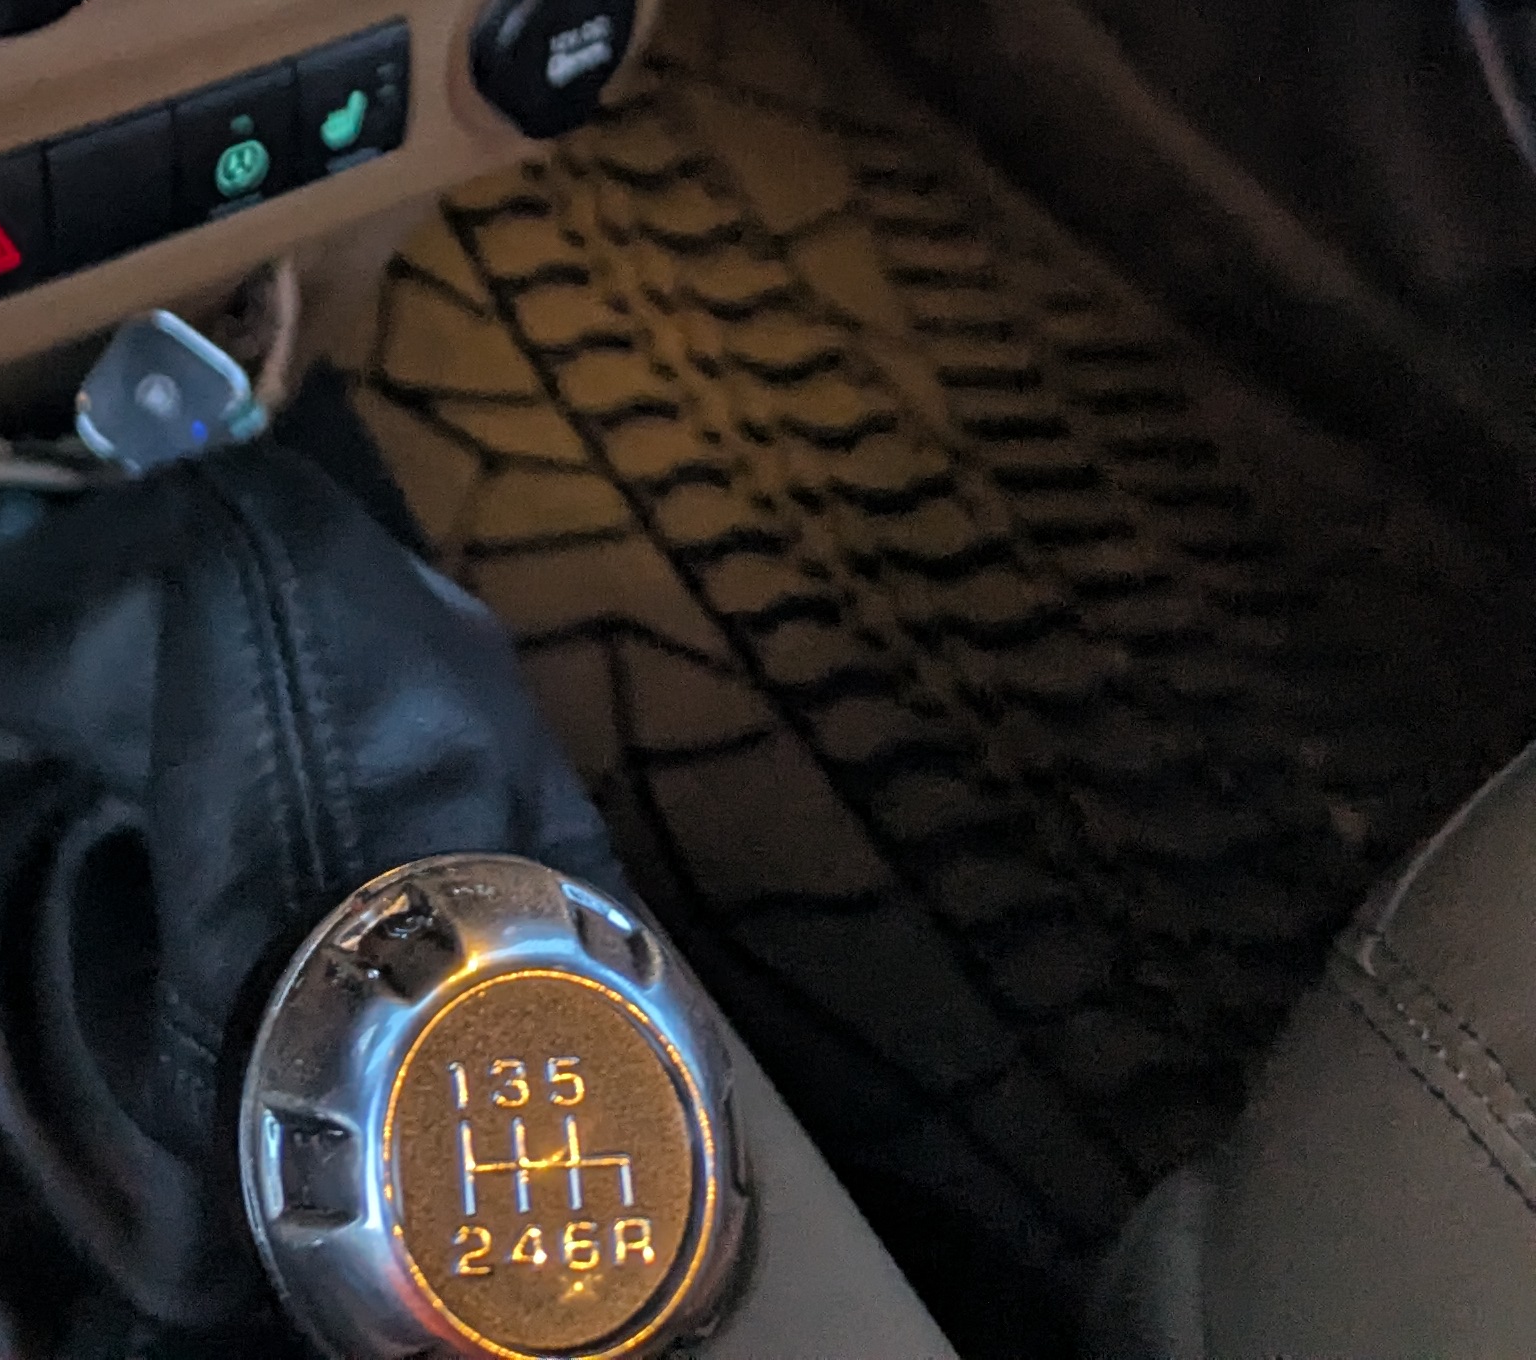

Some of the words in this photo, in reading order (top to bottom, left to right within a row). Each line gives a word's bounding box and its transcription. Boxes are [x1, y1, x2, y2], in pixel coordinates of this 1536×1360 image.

[449, 1061, 469, 1109] 1
[491, 1059, 530, 1107] 3
[547, 1056, 585, 1107] 5
[454, 1225, 493, 1276] 2
[511, 1227, 548, 1266] 4
[563, 1222, 601, 1270] 6
[614, 1218, 655, 1265] R
